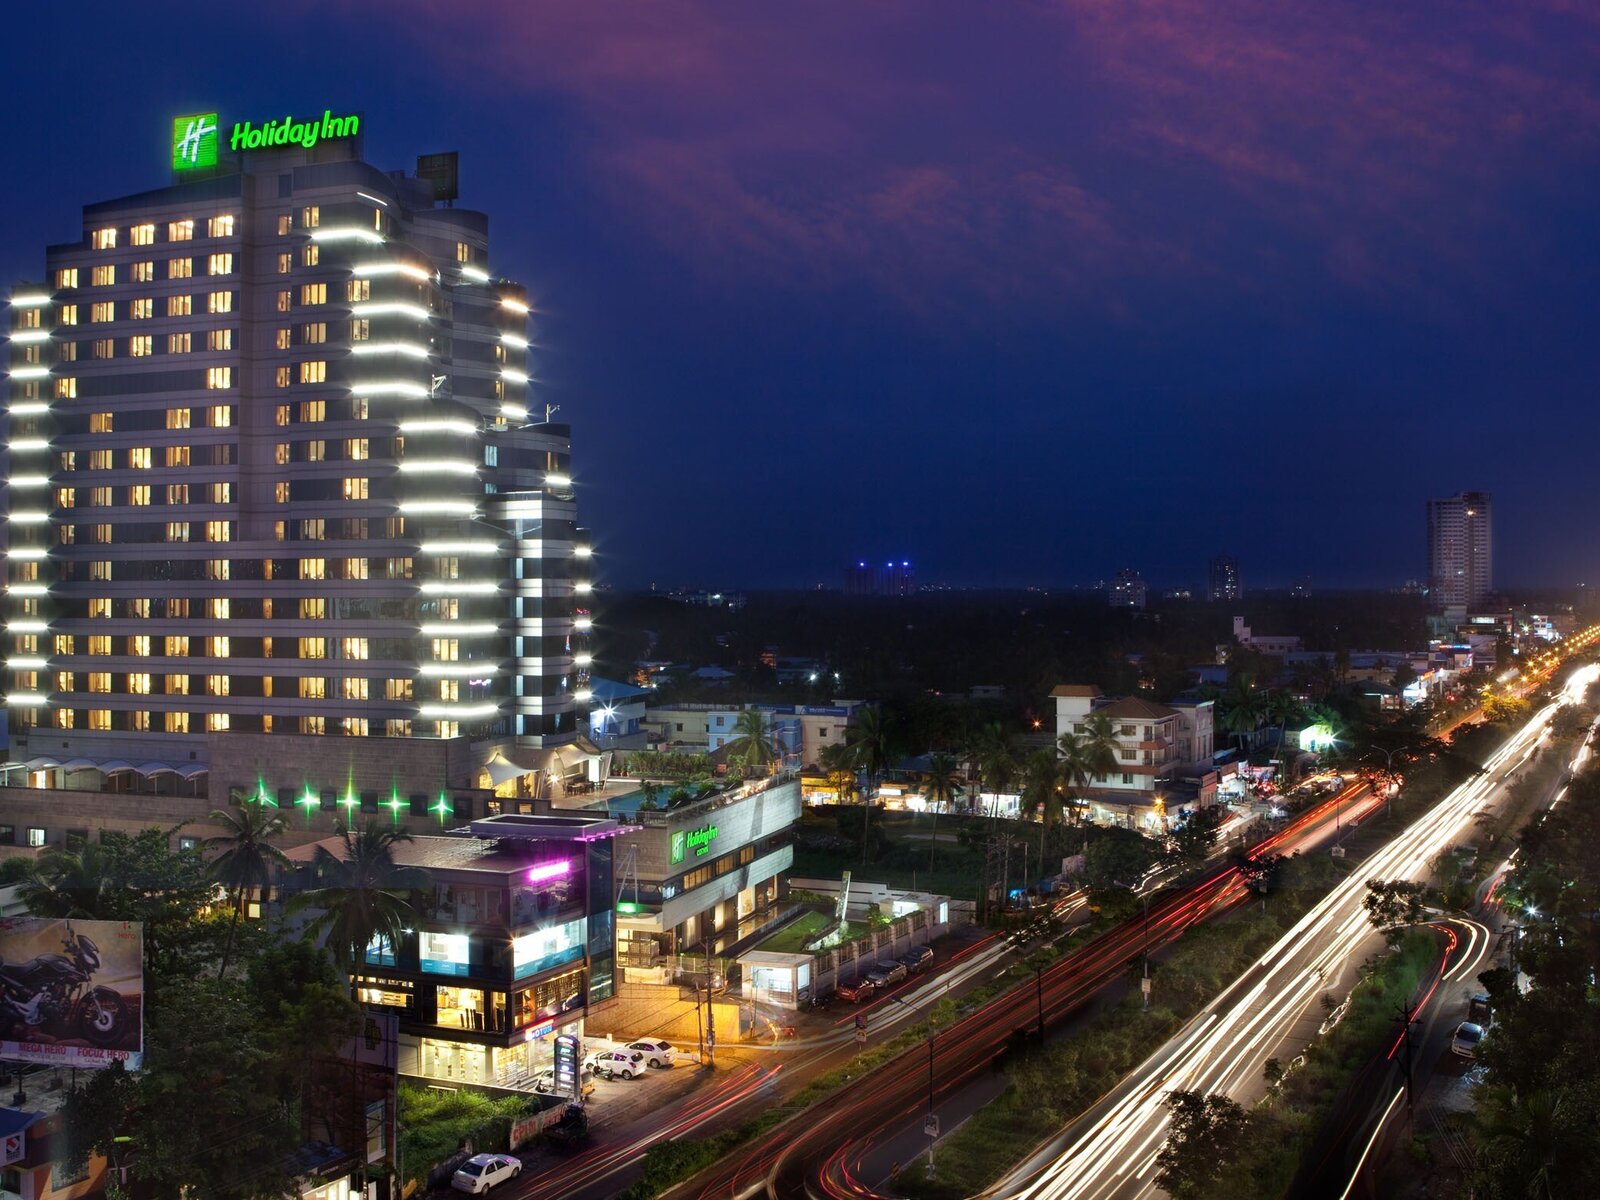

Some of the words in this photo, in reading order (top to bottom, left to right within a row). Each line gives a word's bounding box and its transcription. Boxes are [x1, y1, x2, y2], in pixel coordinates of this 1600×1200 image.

[231, 116, 319, 151] Holiday
[321, 110, 359, 138] Inn
[18, 1042, 42, 1053] MEGA
[44, 1044, 66, 1055] HERO
[77, 1047, 105, 1058] FOCUZ
[107, 1050, 130, 1061] HERO
